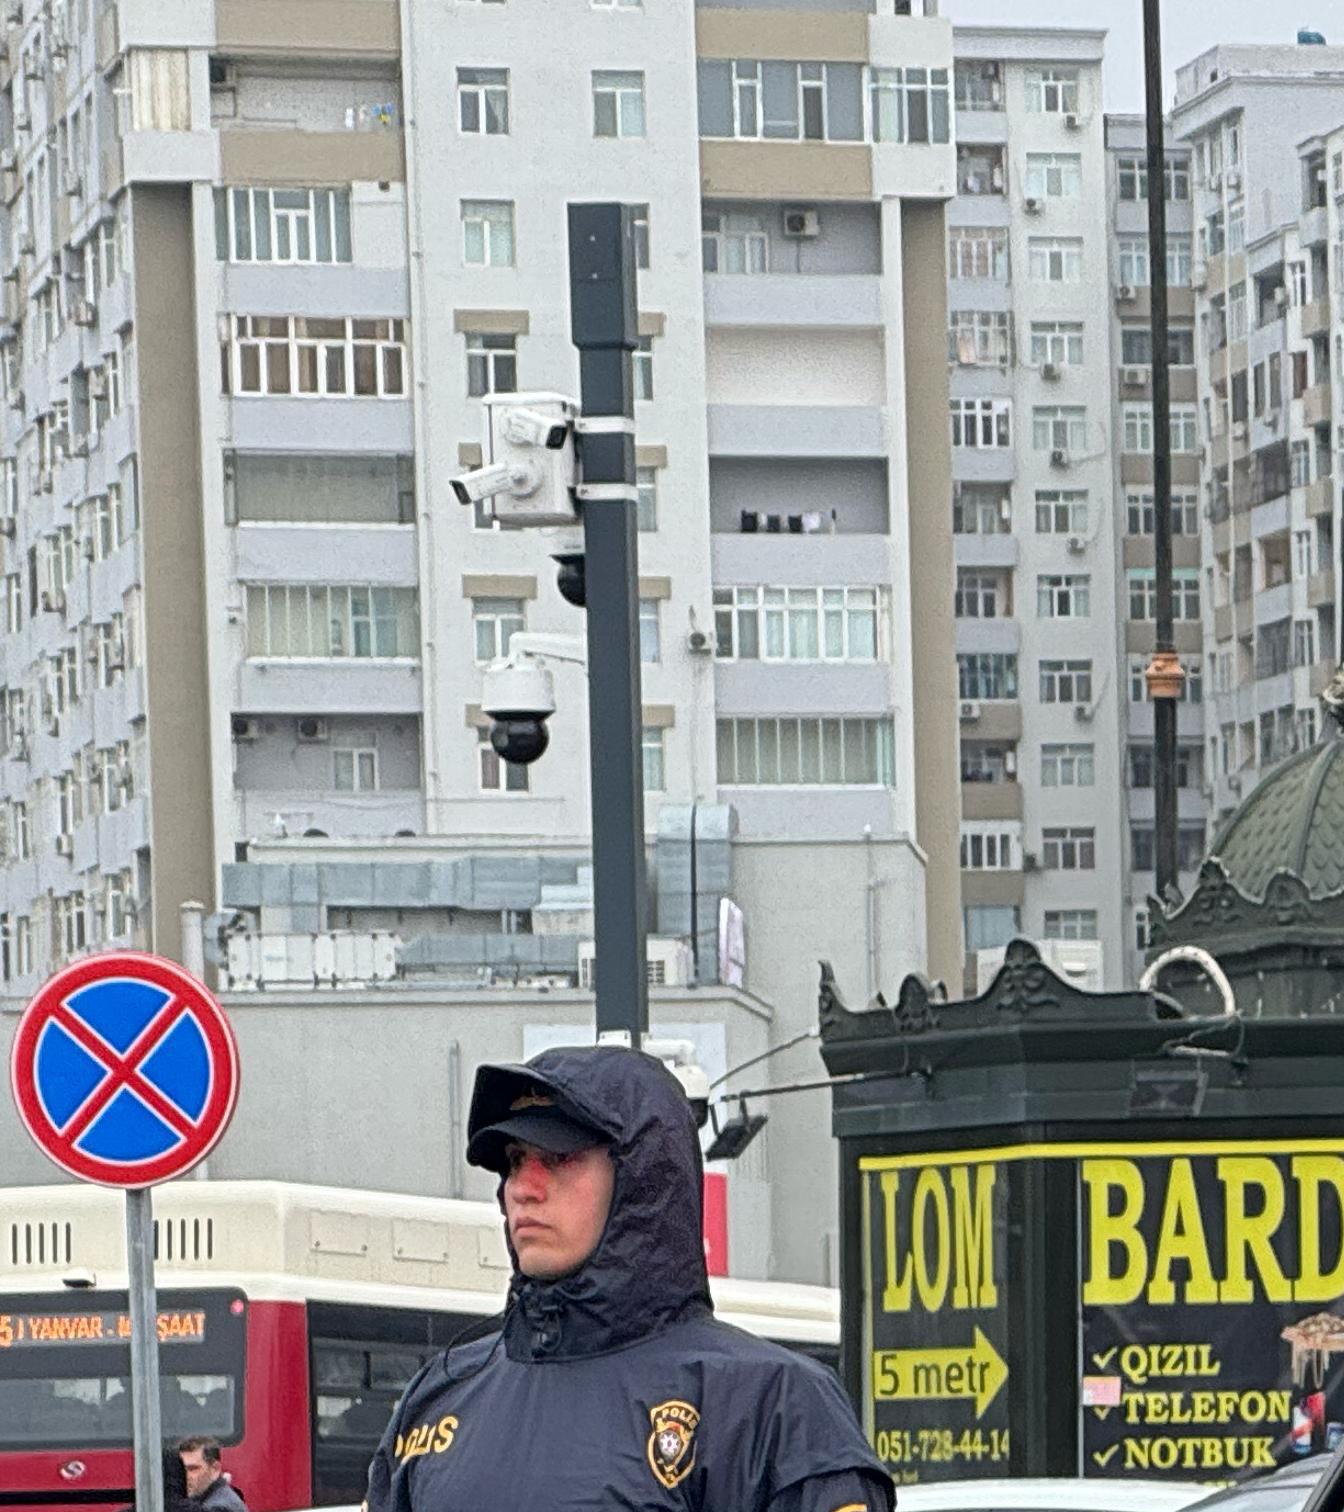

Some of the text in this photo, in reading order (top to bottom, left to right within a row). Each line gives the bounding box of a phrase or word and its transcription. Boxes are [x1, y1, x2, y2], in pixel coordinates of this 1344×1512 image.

[881, 1164, 998, 1313] LOM
[880, 1354, 990, 1396] 5 metr
[1120, 1344, 1221, 1385] QIZIL
[1122, 1390, 1293, 1425] TELEFON
[1124, 1436, 1277, 1469] NOTBUK
